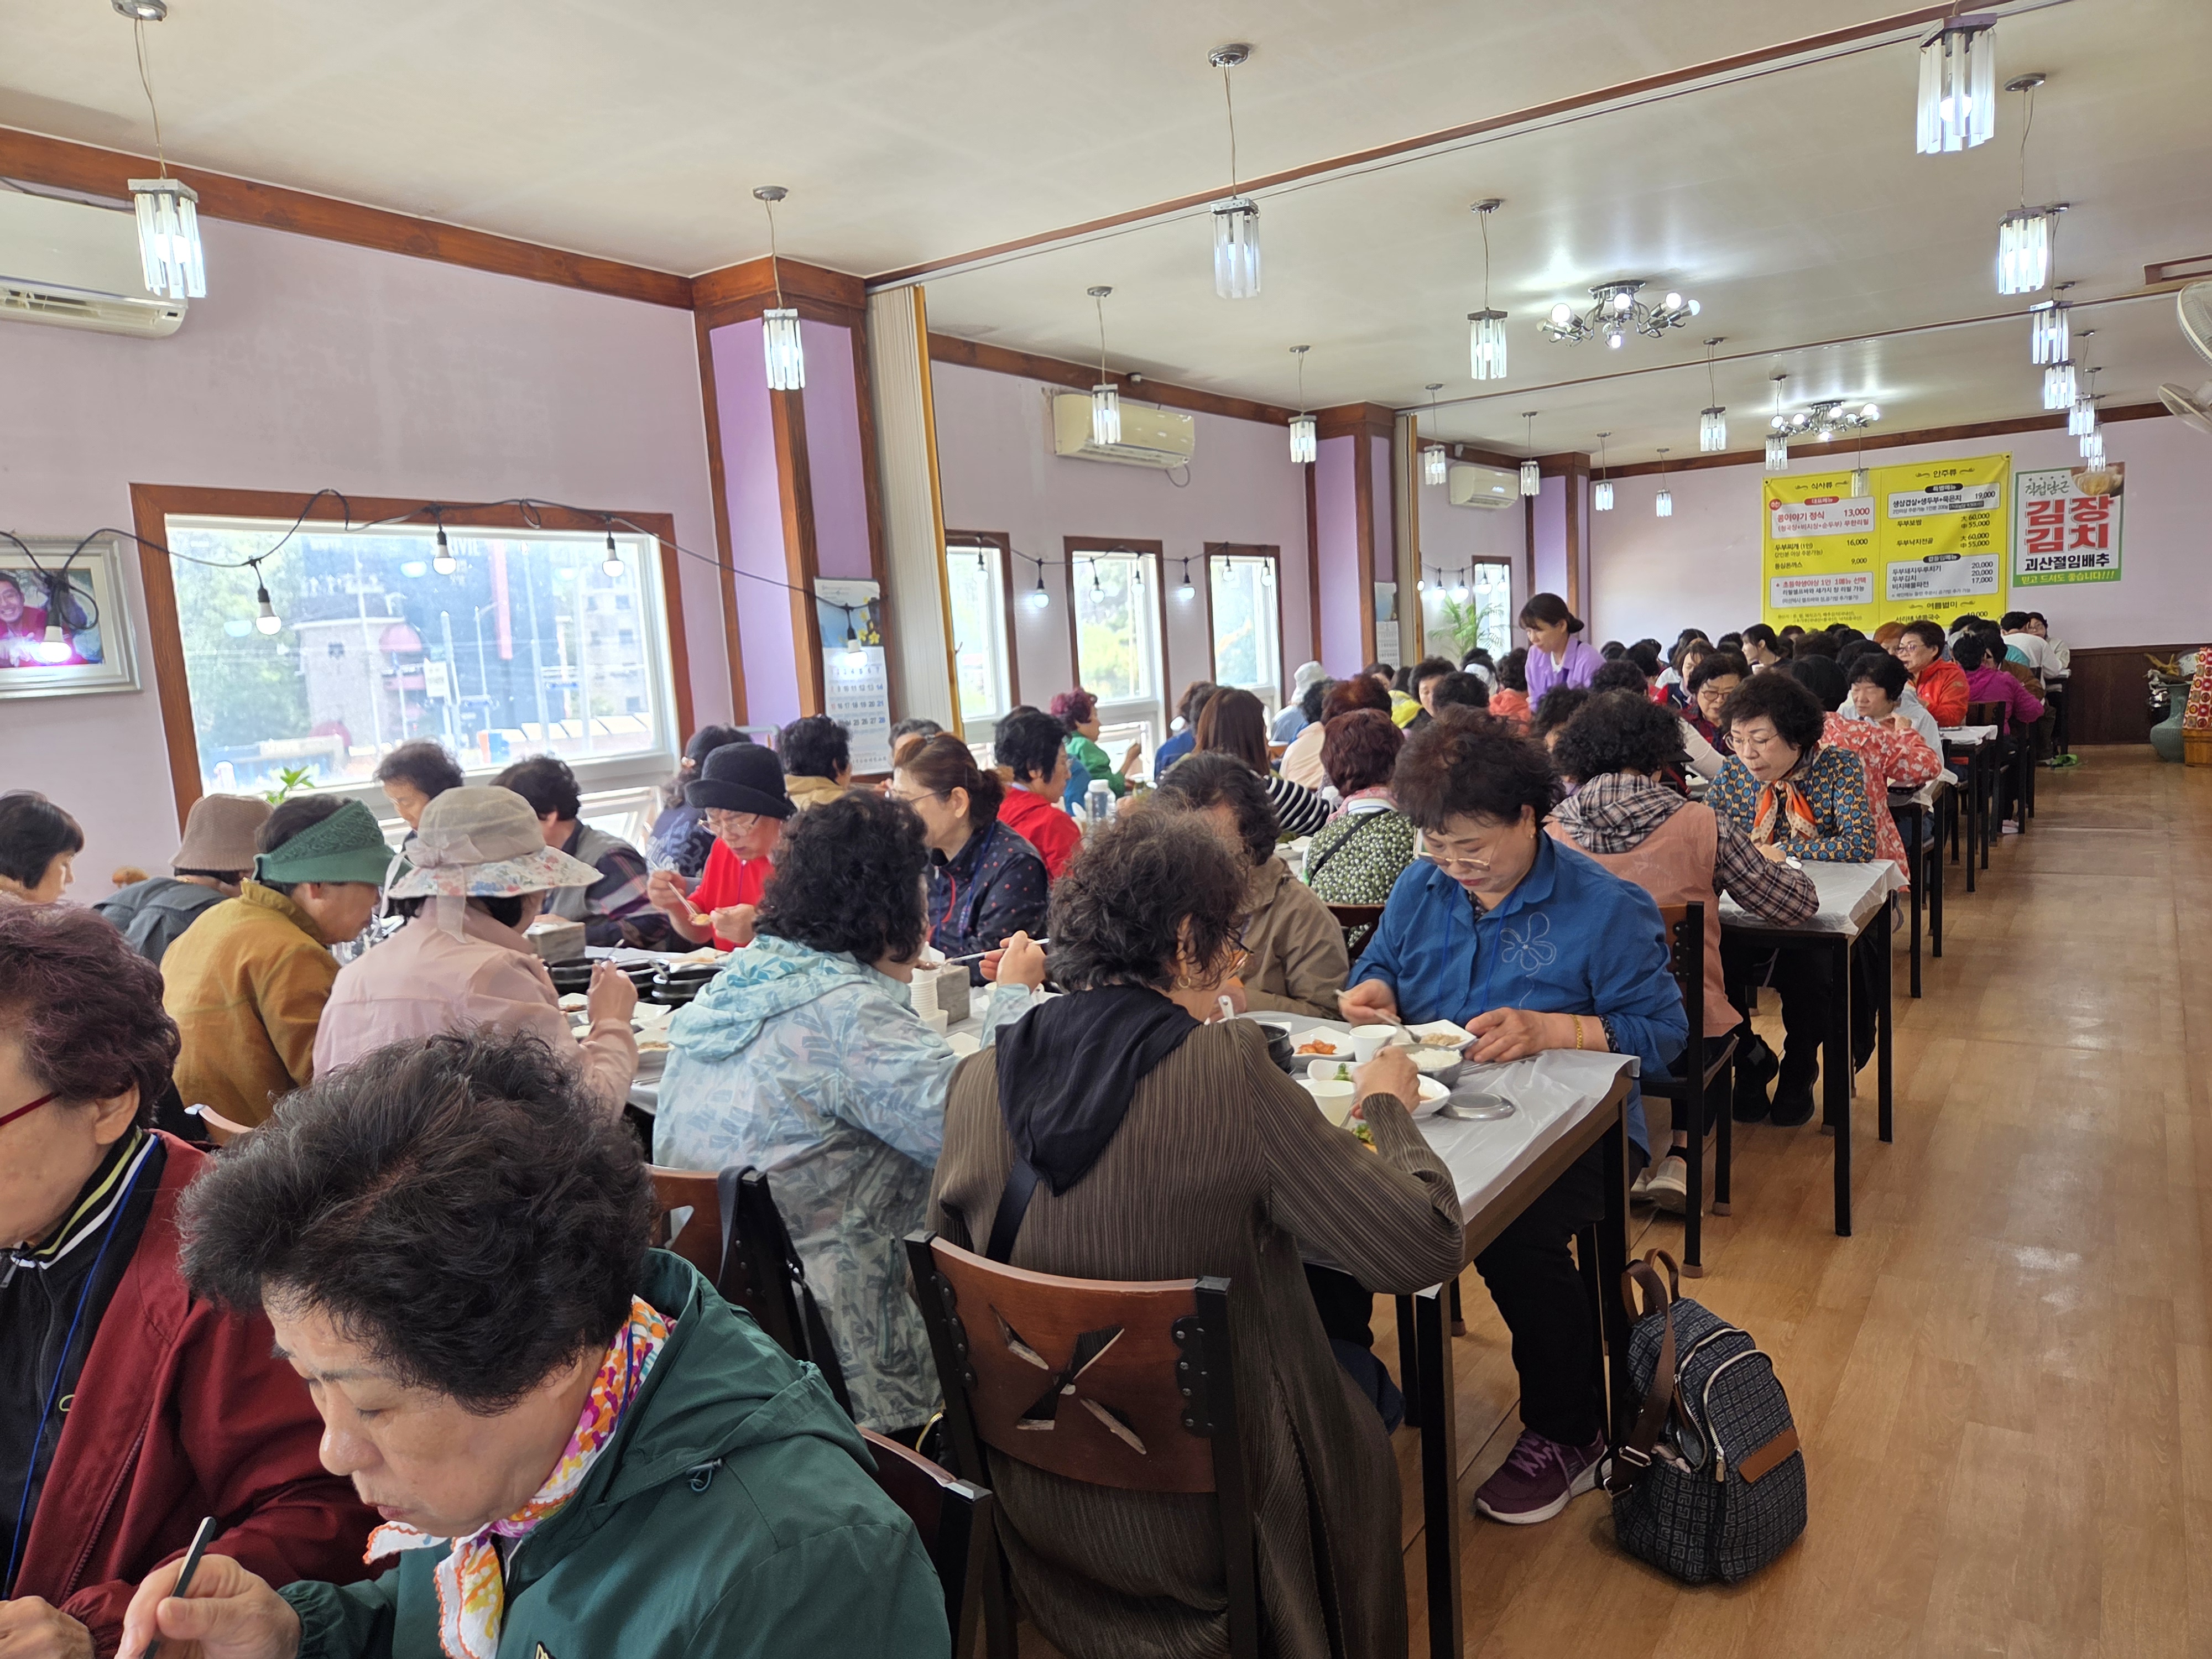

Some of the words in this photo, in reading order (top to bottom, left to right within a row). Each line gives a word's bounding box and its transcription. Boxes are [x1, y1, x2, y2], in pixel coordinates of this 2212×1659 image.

[1934, 469, 1957, 478] 안주류
[1811, 482, 1833, 490] 식사류
[2025, 481, 2070, 496] 직접담근
[1975, 491, 1995, 499] 19,000
[1809, 511, 1824, 520] 정식
[1844, 508, 1870, 517] 13,000
[2026, 495, 2114, 526] 김장
[1897, 519, 1922, 528] 두부보쌈
[1969, 513, 1990, 521] 60,000
[1969, 520, 1990, 528] 55,000
[1897, 538, 1933, 546] 두부낙지전골
[2025, 524, 2109, 554] 김치
[2025, 553, 2110, 571] 괴산절임배추
[2021, 576, 2038, 585] 믿고
[2068, 571, 2115, 581] 좋습니다!!!
[1927, 601, 1958, 610] 여름별미
